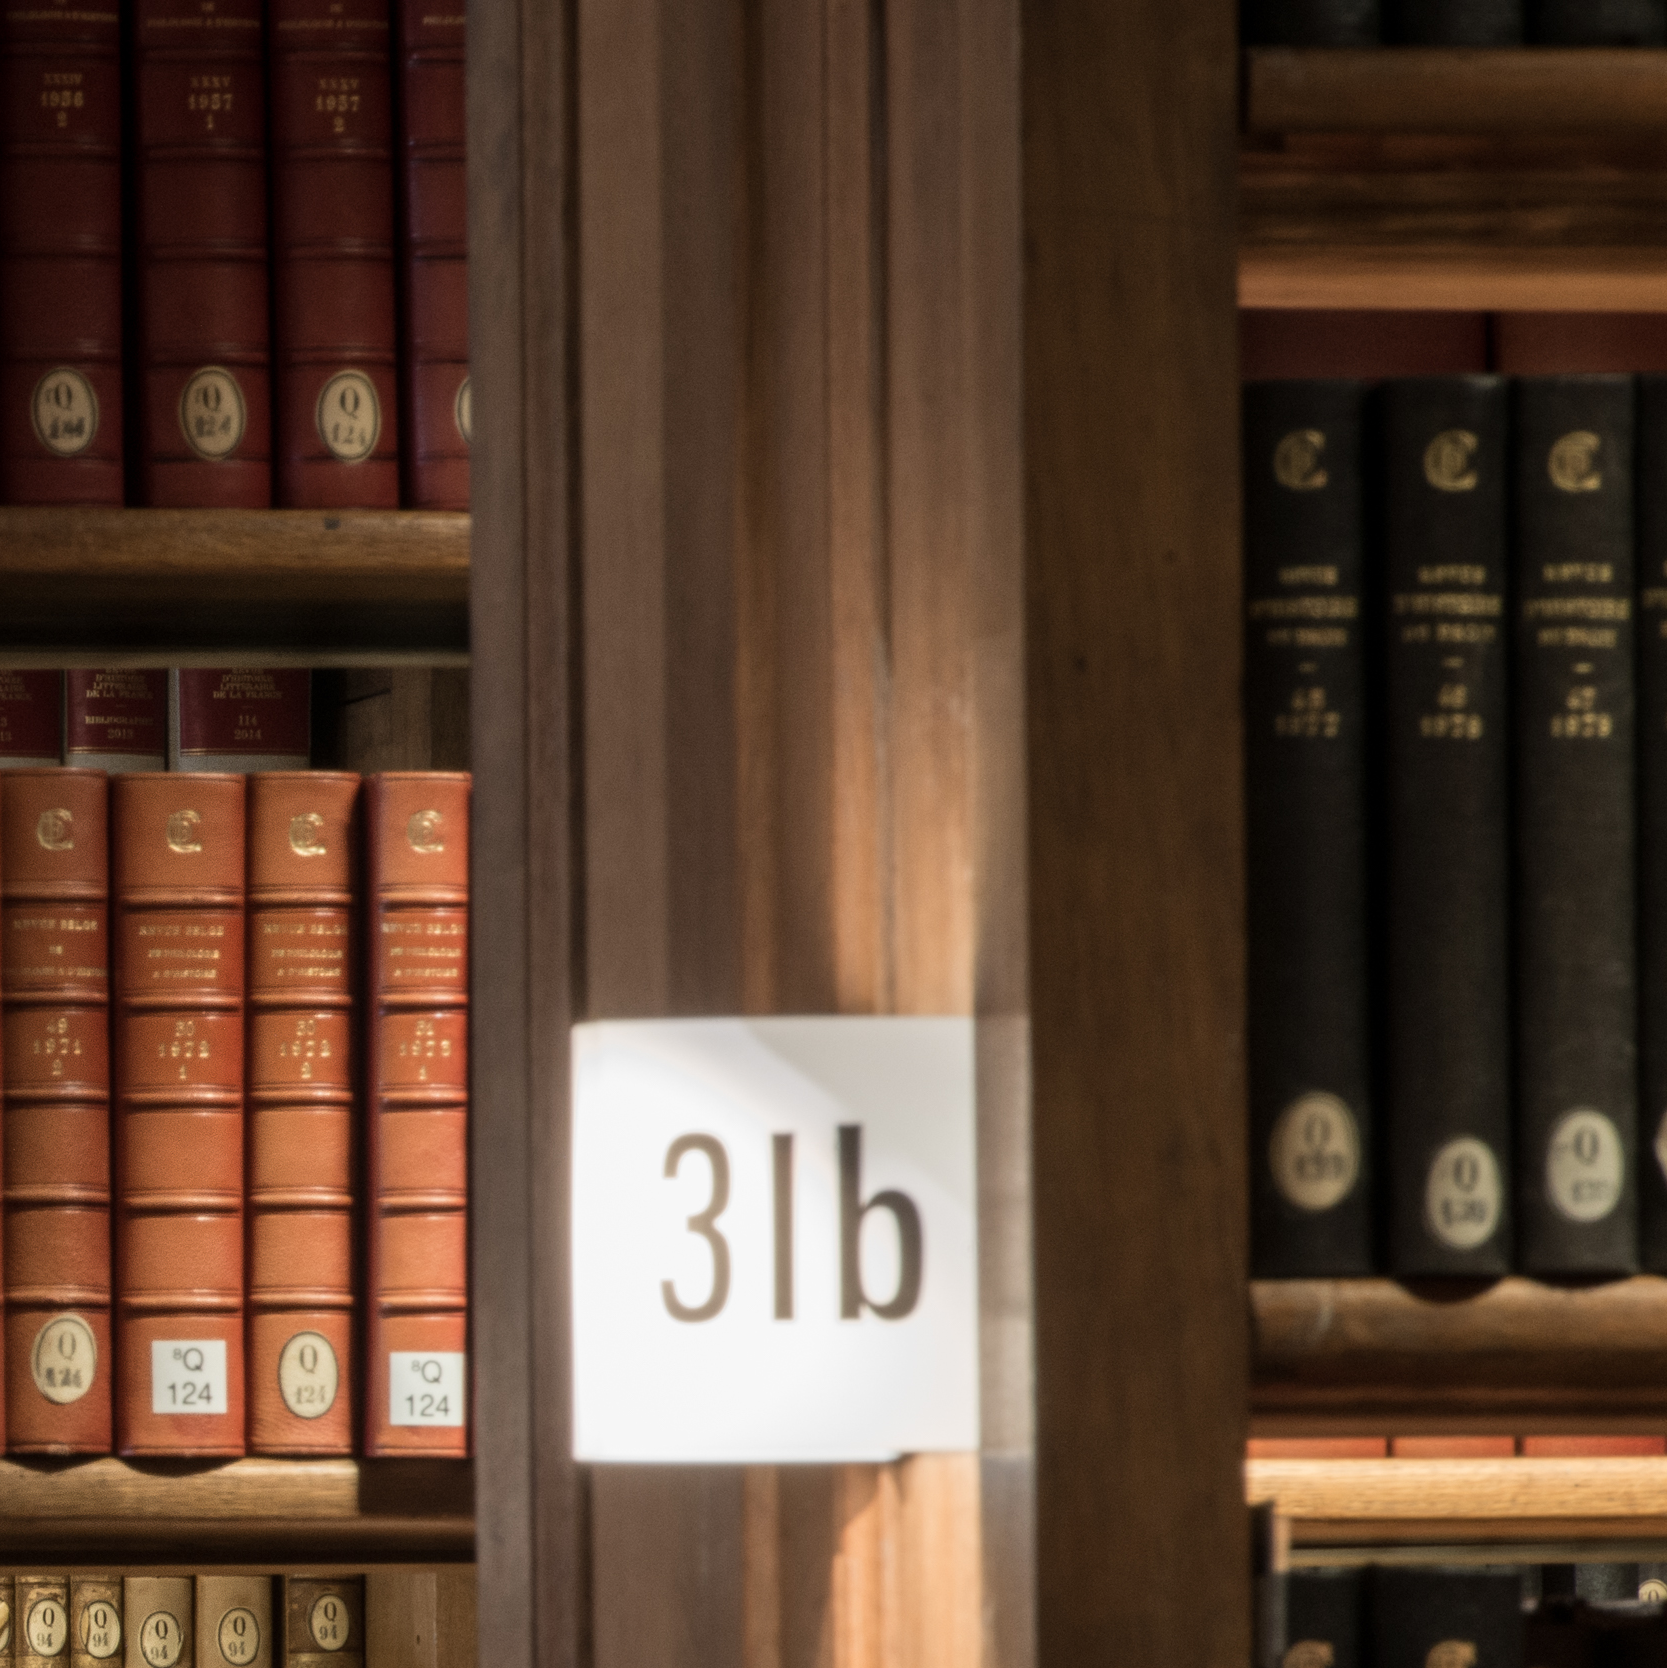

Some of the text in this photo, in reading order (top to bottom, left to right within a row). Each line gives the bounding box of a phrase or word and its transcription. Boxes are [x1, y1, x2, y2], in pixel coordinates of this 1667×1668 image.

[665, 1122, 924, 1321] 3Ib
[299, 1344, 318, 1373] Q
[168, 1382, 212, 1405] 124
[406, 1394, 449, 1417] 124
